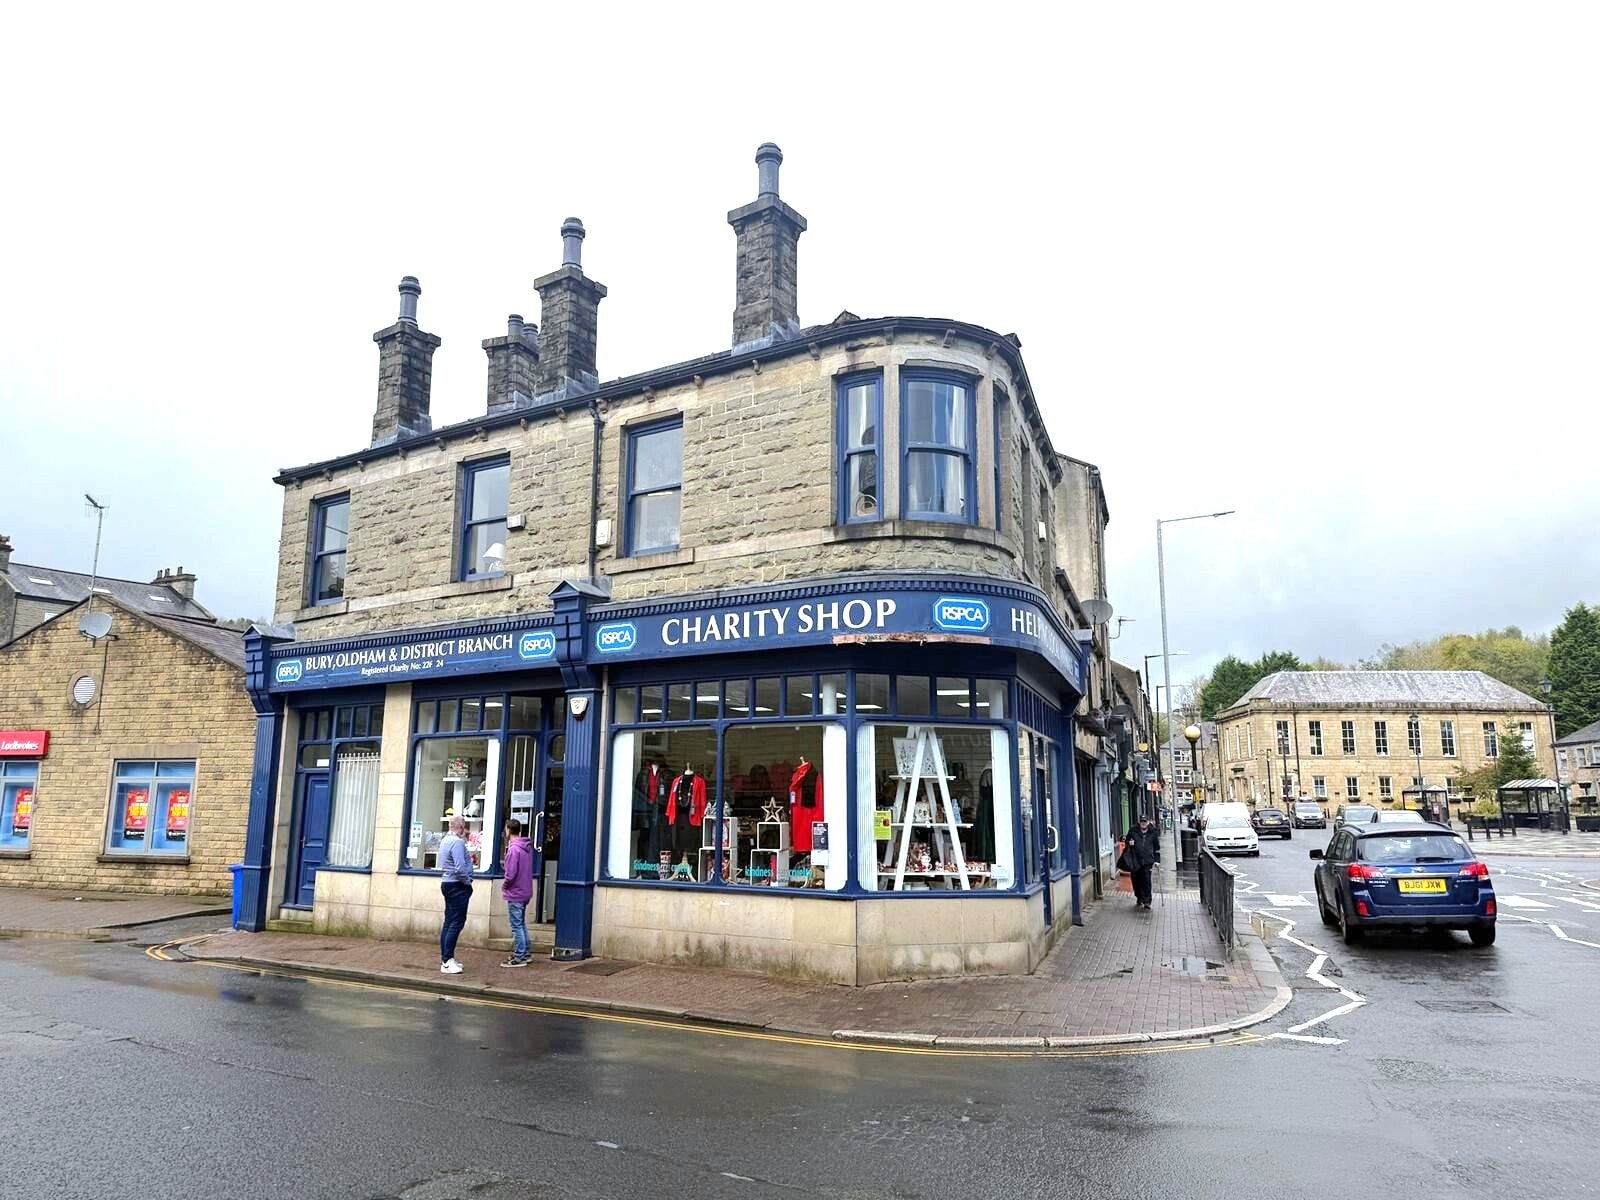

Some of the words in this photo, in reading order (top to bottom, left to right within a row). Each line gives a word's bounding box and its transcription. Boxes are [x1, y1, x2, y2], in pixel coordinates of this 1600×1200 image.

[942, 606, 983, 622] RSPCA
[662, 607, 789, 646] CHARITY
[798, 599, 896, 633] SHOP
[523, 637, 550, 651] RSPCA
[601, 630, 632, 645] RSPCA
[388, 647, 398, 661] &
[400, 641, 455, 661] DISTRICT
[458, 634, 513, 654] BRANCH
[278, 665, 299, 677] RSPCA
[361, 664, 389, 677] Registered
[389, 662, 410, 673] Charity
[1, 740, 40, 751] Ladbrokes
[1425, 880, 1441, 889] JXW
